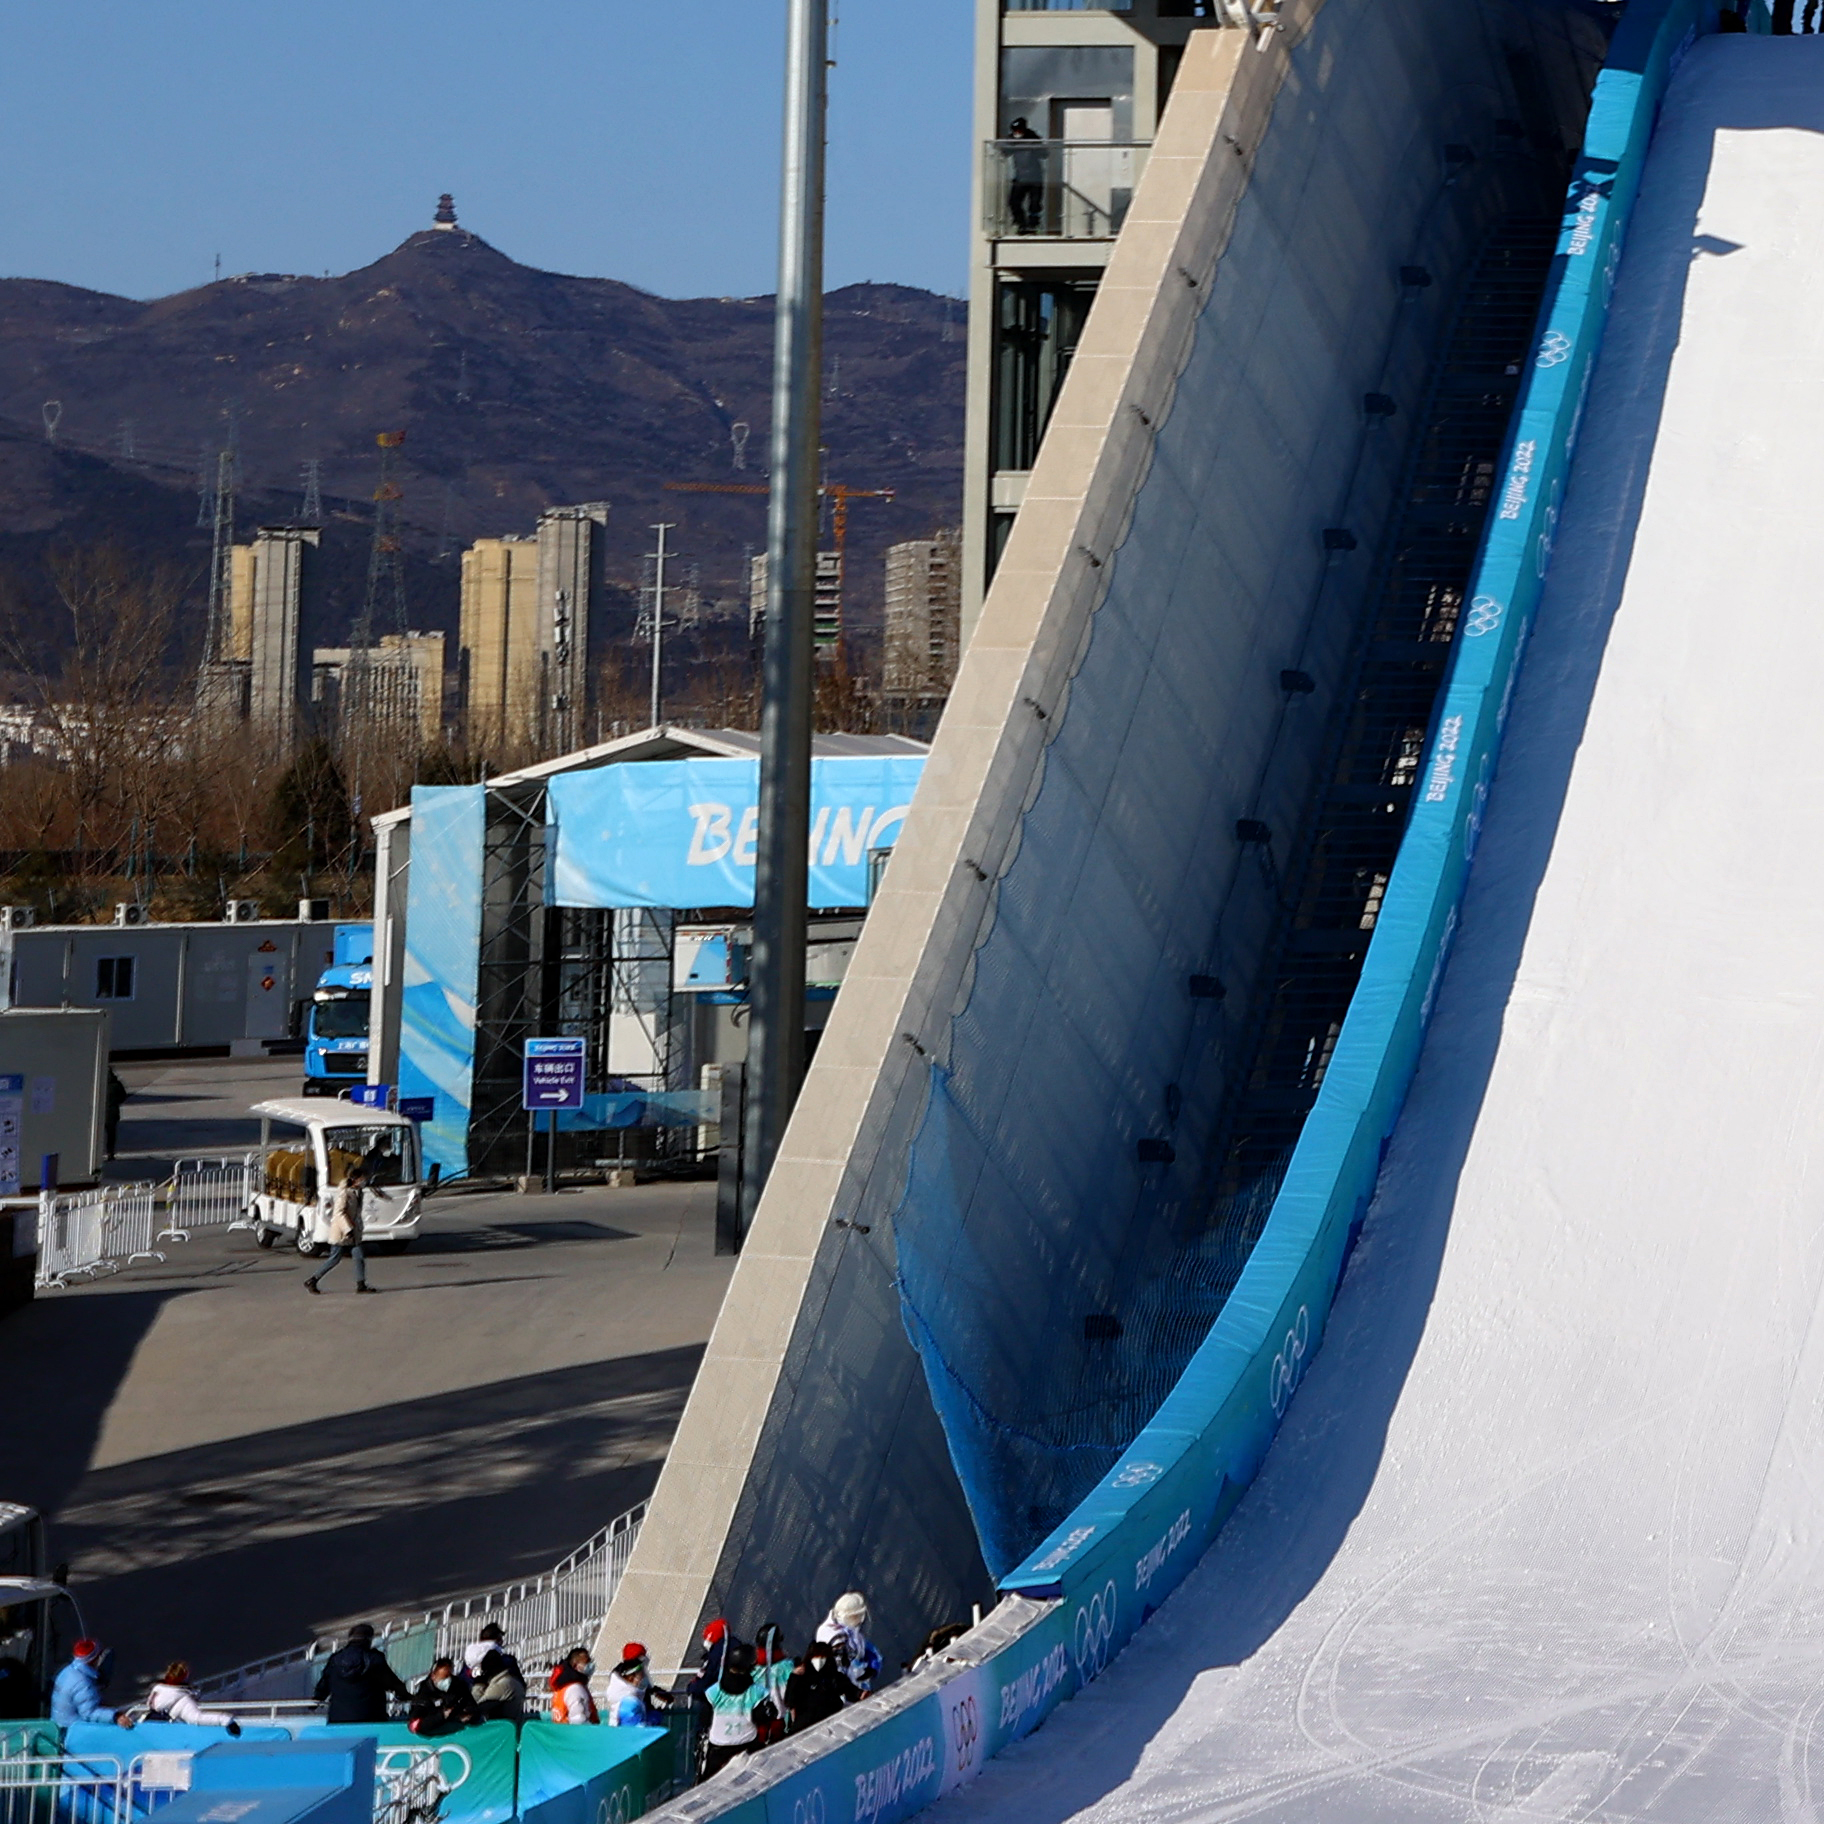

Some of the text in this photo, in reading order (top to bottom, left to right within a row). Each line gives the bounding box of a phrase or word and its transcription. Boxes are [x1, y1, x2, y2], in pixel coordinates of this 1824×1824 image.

[1566, 184, 1600, 255] BEIJING 2022
[1499, 439, 1536, 520] BEIJING 2022
[1425, 714, 1463, 803] BEIJING 2022
[855, 1736, 936, 1824] BEIJING 2022
